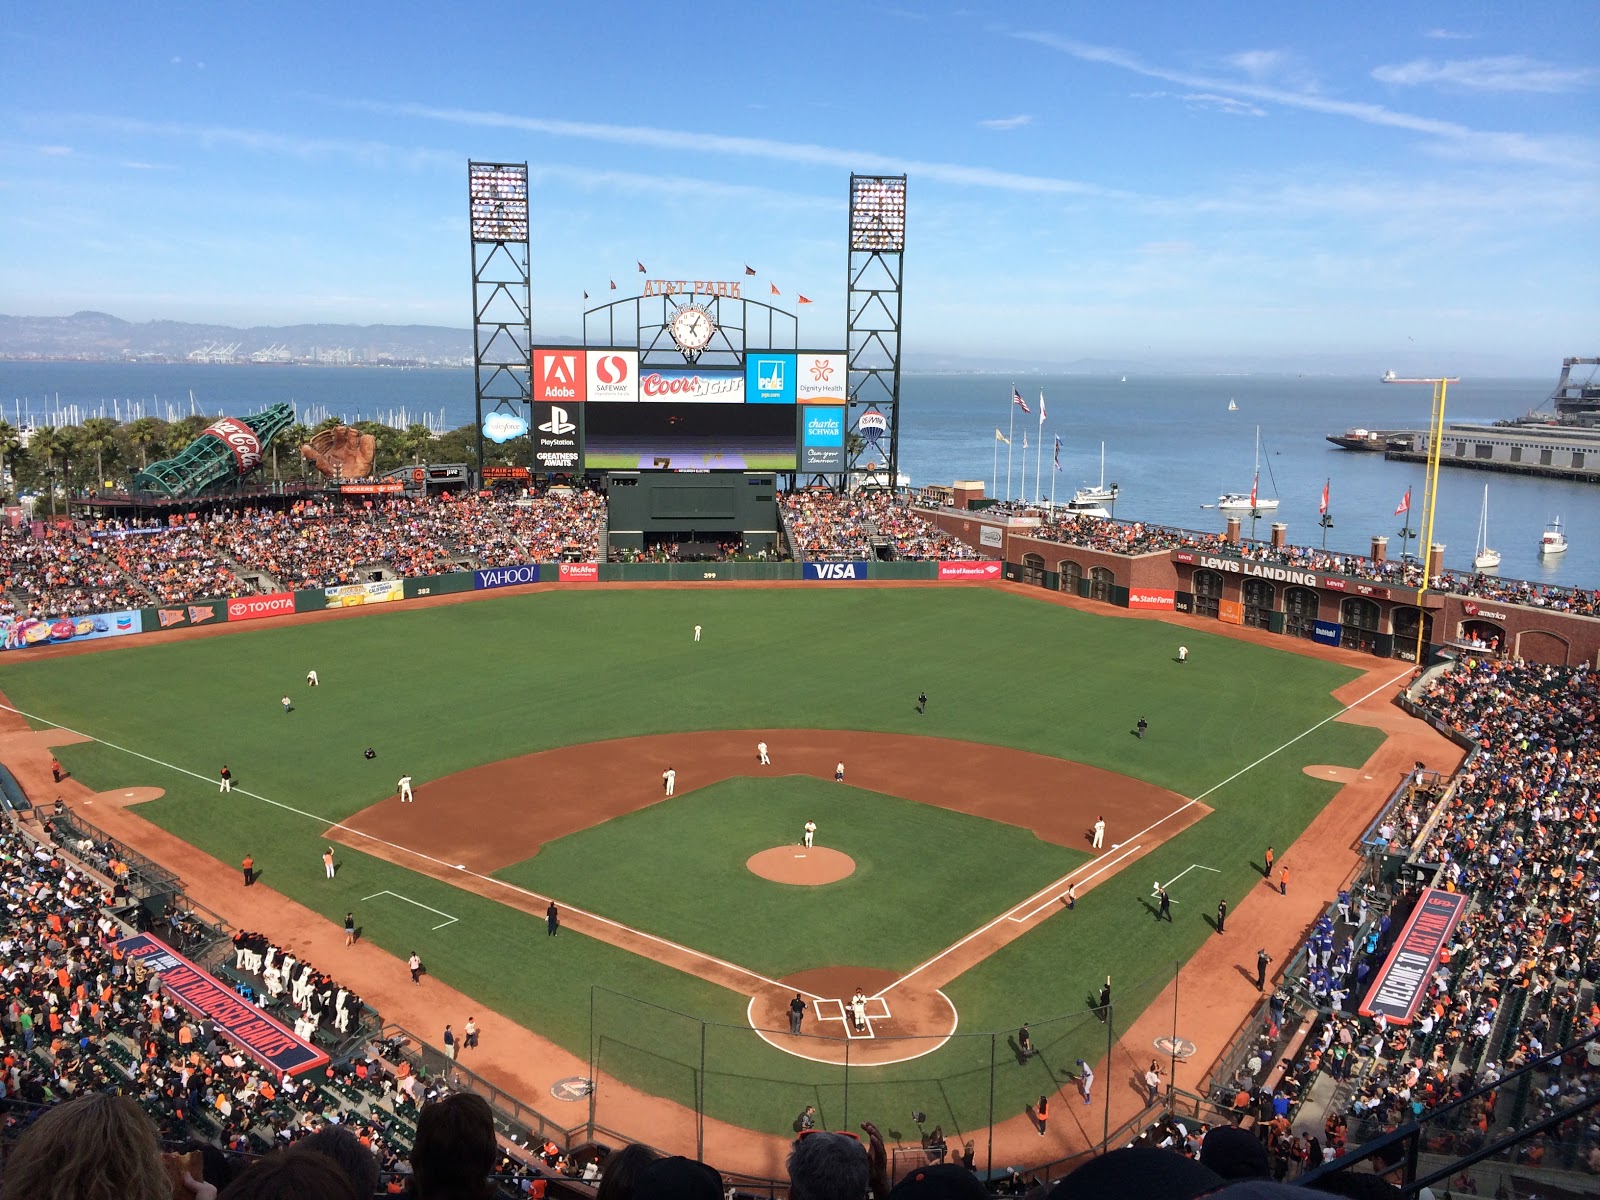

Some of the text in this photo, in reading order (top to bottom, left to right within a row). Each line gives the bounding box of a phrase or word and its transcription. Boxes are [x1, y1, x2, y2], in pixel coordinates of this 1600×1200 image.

[643, 280, 740, 300] AT&T PARK
[674, 344, 711, 356] GIANTS
[642, 373, 699, 396] Coors
[760, 377, 783, 389] PG&E
[545, 386, 575, 398] Adobe
[800, 384, 843, 393] Dignity Health
[490, 422, 520, 432] salesforce
[808, 418, 840, 428] charles
[808, 428, 840, 436] SCHWAB
[540, 439, 574, 447] PlayStation
[536, 452, 579, 460] GREATNESS
[812, 563, 856, 579] VISA
[942, 567, 956, 575] Bank
[1243, 563, 1317, 587] LANDING
[480, 566, 535, 588] YAHOO!
[368, 584, 393, 594] CALIFORNIA
[417, 587, 430, 595] 382
[247, 598, 294, 613] TOYOTA
[1176, 602, 1188, 610] 365
[1477, 610, 1507, 620] america
[1401, 651, 1416, 661] 309
[1375, 911, 1450, 1008] WELCOME TO AT&T PARK
[160, 966, 298, 1057] SAN FRANCISCO GIANTS
